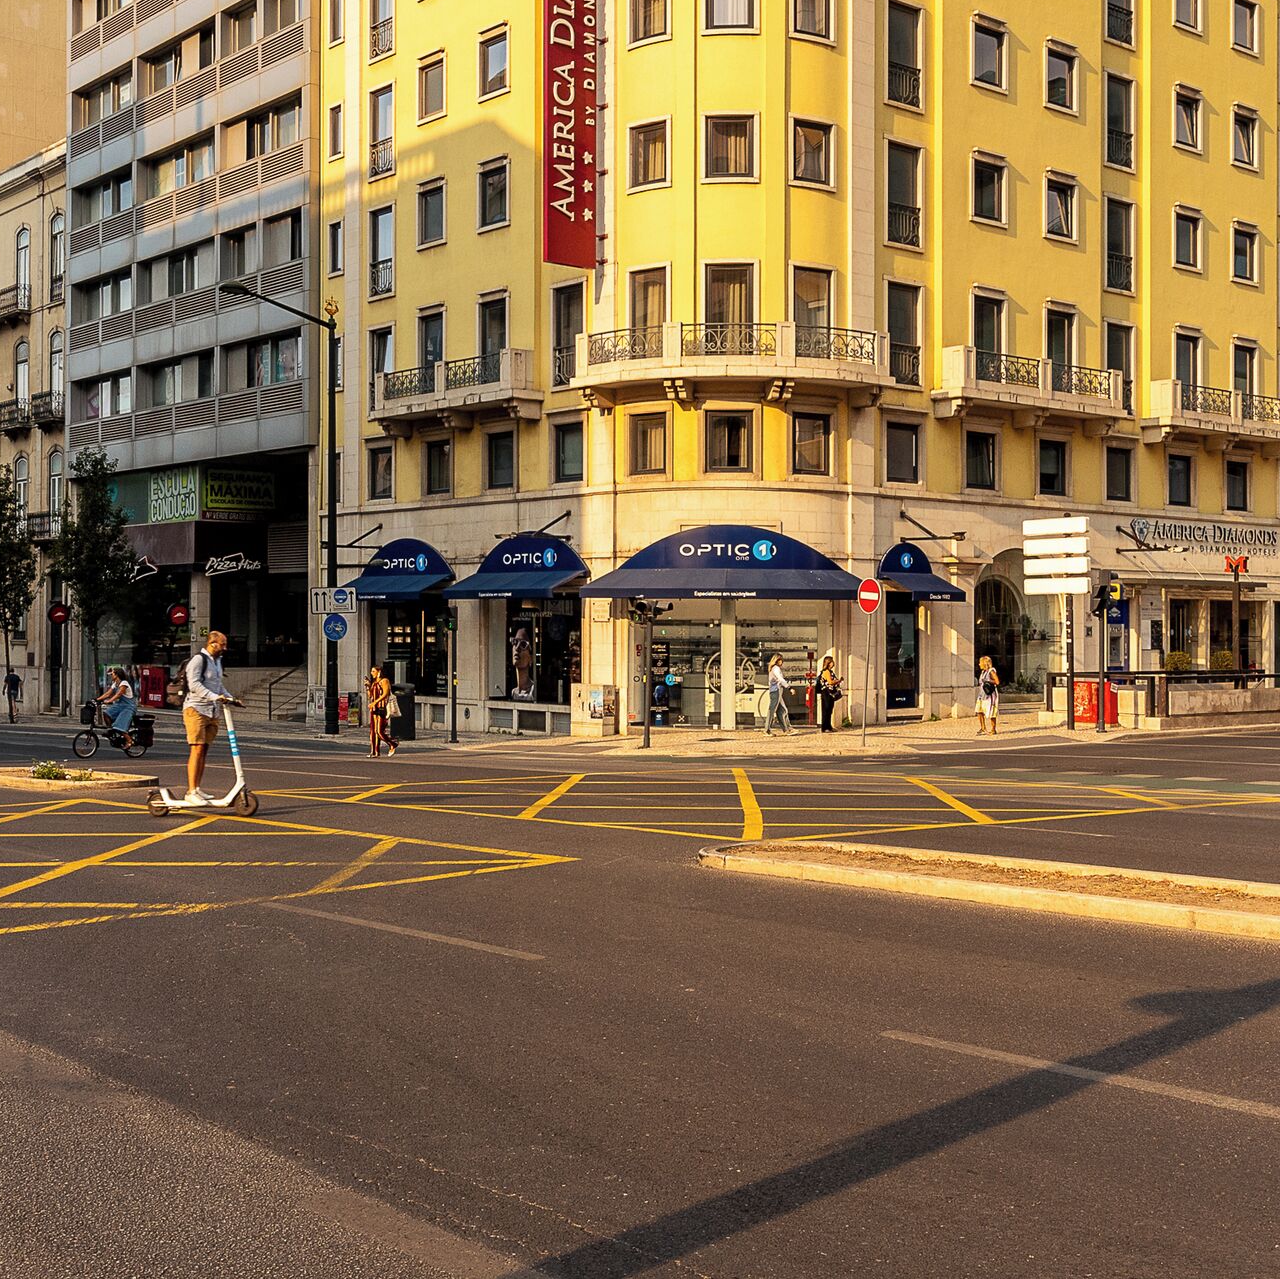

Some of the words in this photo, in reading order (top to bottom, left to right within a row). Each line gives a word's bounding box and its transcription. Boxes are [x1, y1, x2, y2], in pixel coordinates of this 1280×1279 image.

[584, 106, 596, 127] BY
[550, 60, 575, 222] AMERICA
[150, 468, 195, 500] ESCOLA
[210, 472, 272, 486] SEGURANÇA
[150, 492, 197, 522] CONDUÇÃO
[1152, 520, 1209, 543] AMERICA
[1212, 524, 1278, 547] DIAMONDS
[679, 543, 750, 556] OPTIC
[1200, 544, 1243, 554] DIAMONDS
[1247, 548, 1277, 557] HOTELS
[205, 557, 237, 571] Pizza
[383, 557, 416, 570] OPTIC
[502, 552, 542, 565] OPTIC
[1224, 555, 1249, 573] M
